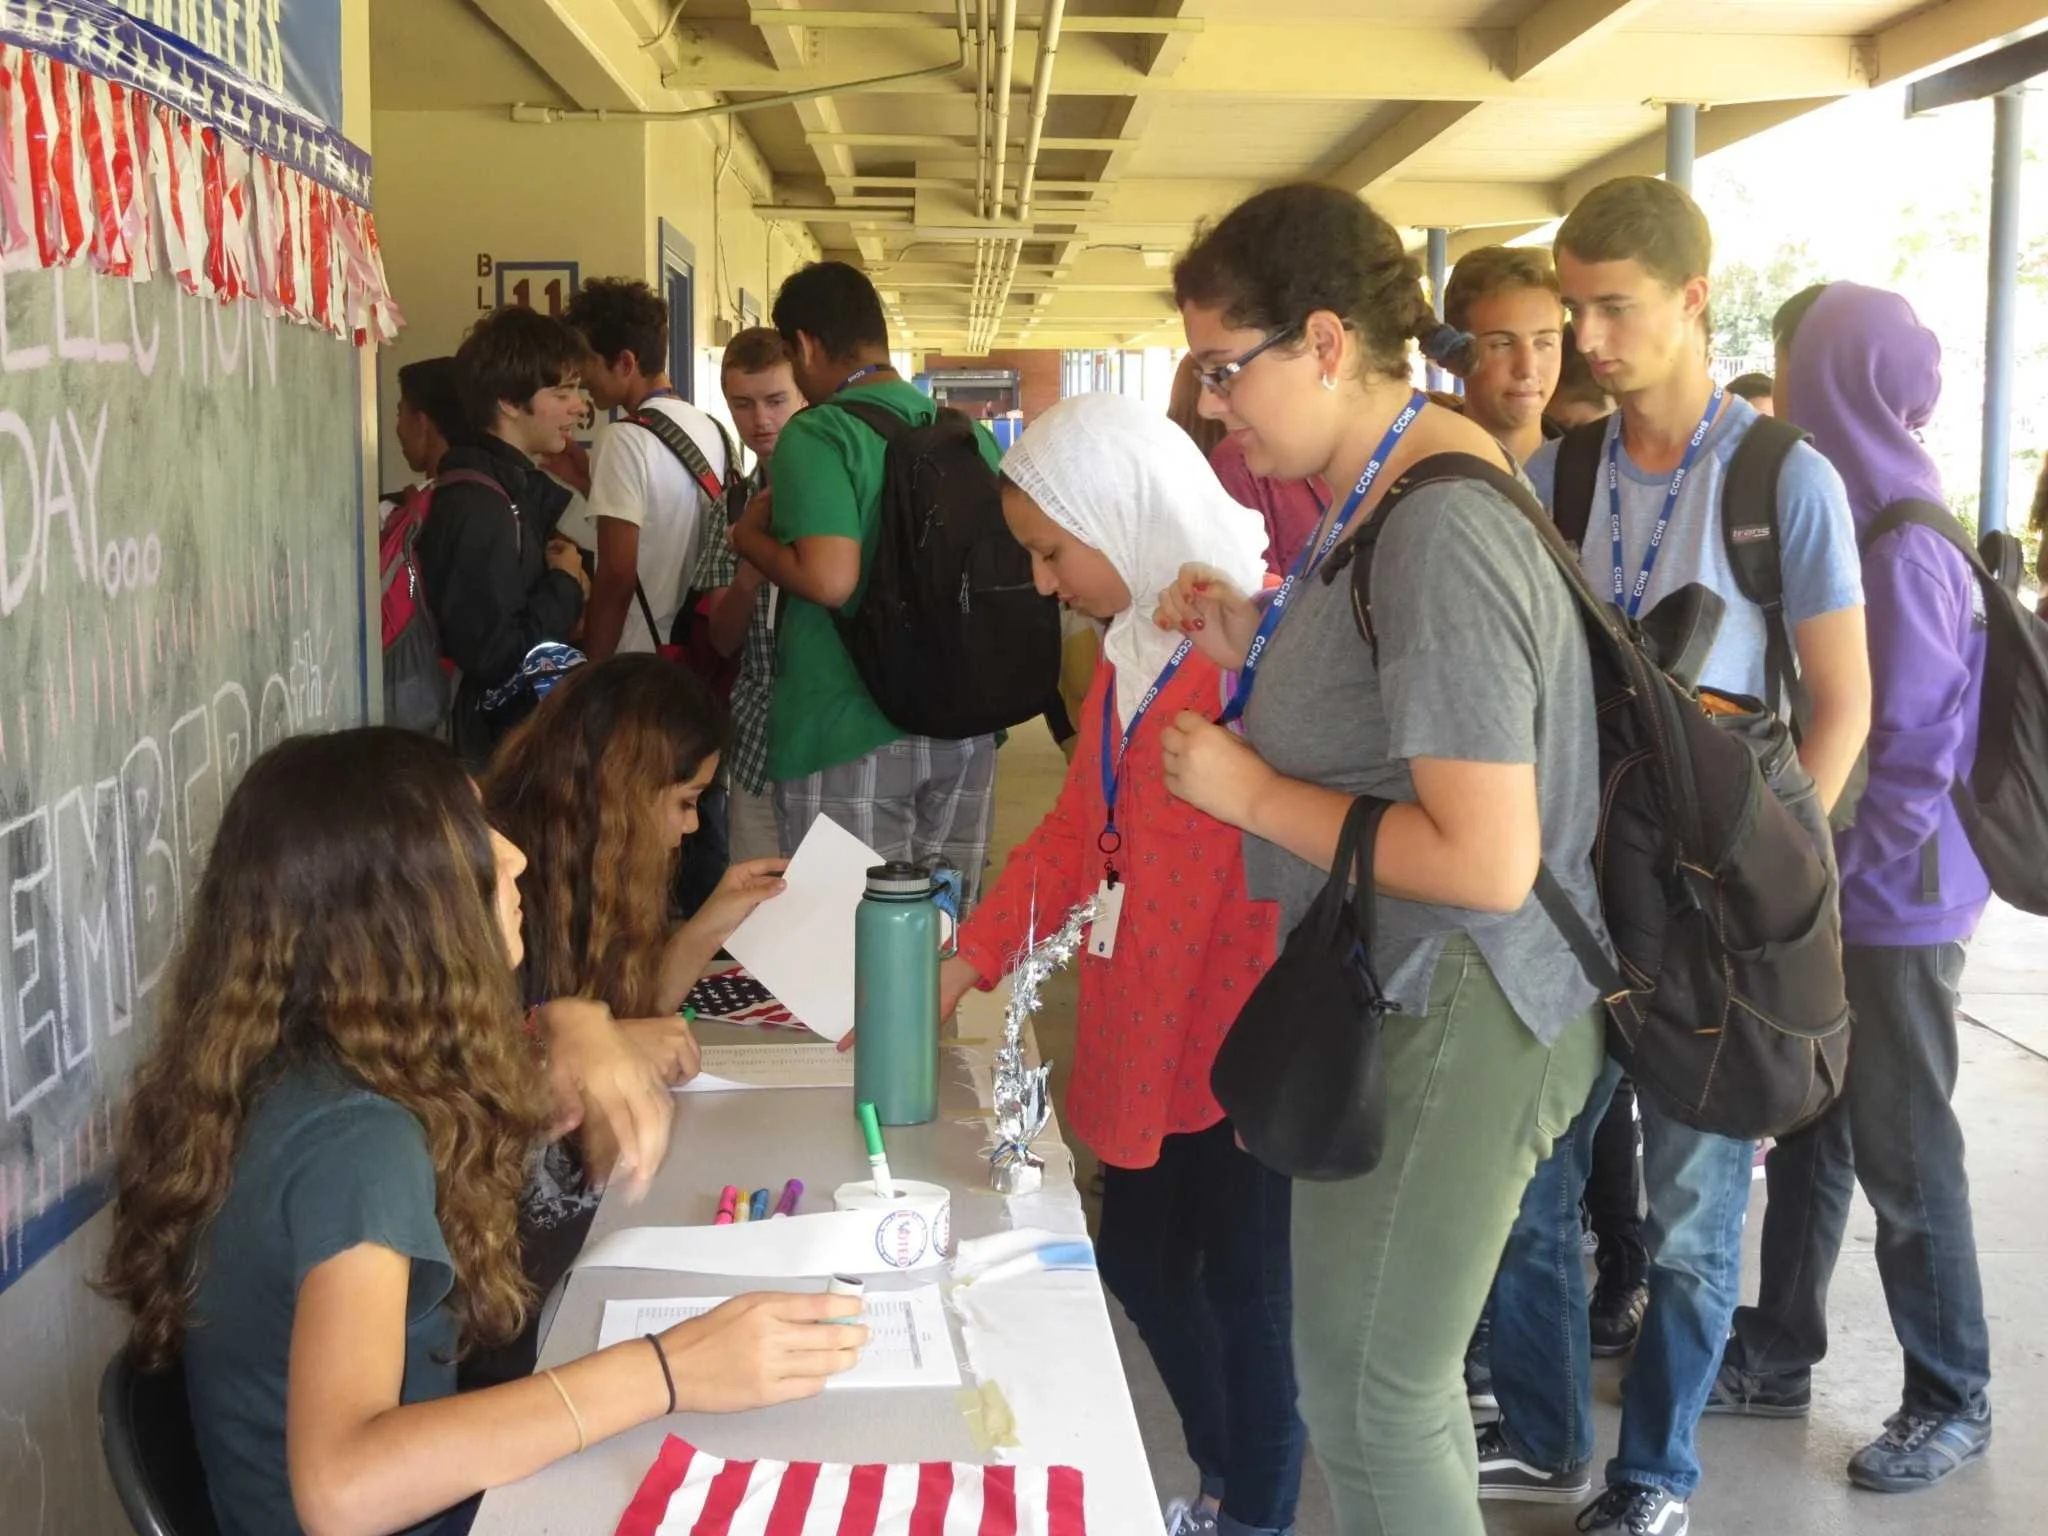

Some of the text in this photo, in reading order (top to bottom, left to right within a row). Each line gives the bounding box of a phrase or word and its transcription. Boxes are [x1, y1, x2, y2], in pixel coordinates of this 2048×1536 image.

[512, 278, 562, 315] 11
[1393, 406, 1417, 433] CCHS
[1691, 420, 1710, 446] CCHS
[1355, 459, 1380, 494] CCHS
[1670, 468, 1685, 496] CCHS
[1321, 521, 1344, 553] CCHS
[1611, 514, 1620, 542] CCHS
[1652, 519, 1667, 547] CCHS
[1273, 575, 1295, 607] CCHS
[1614, 566, 1623, 594] CCHS
[1633, 570, 1649, 598] CCHS
[1171, 639, 1193, 666] CCHS
[1246, 635, 1266, 668] CCHS
[1138, 687, 1158, 713] CCHS
